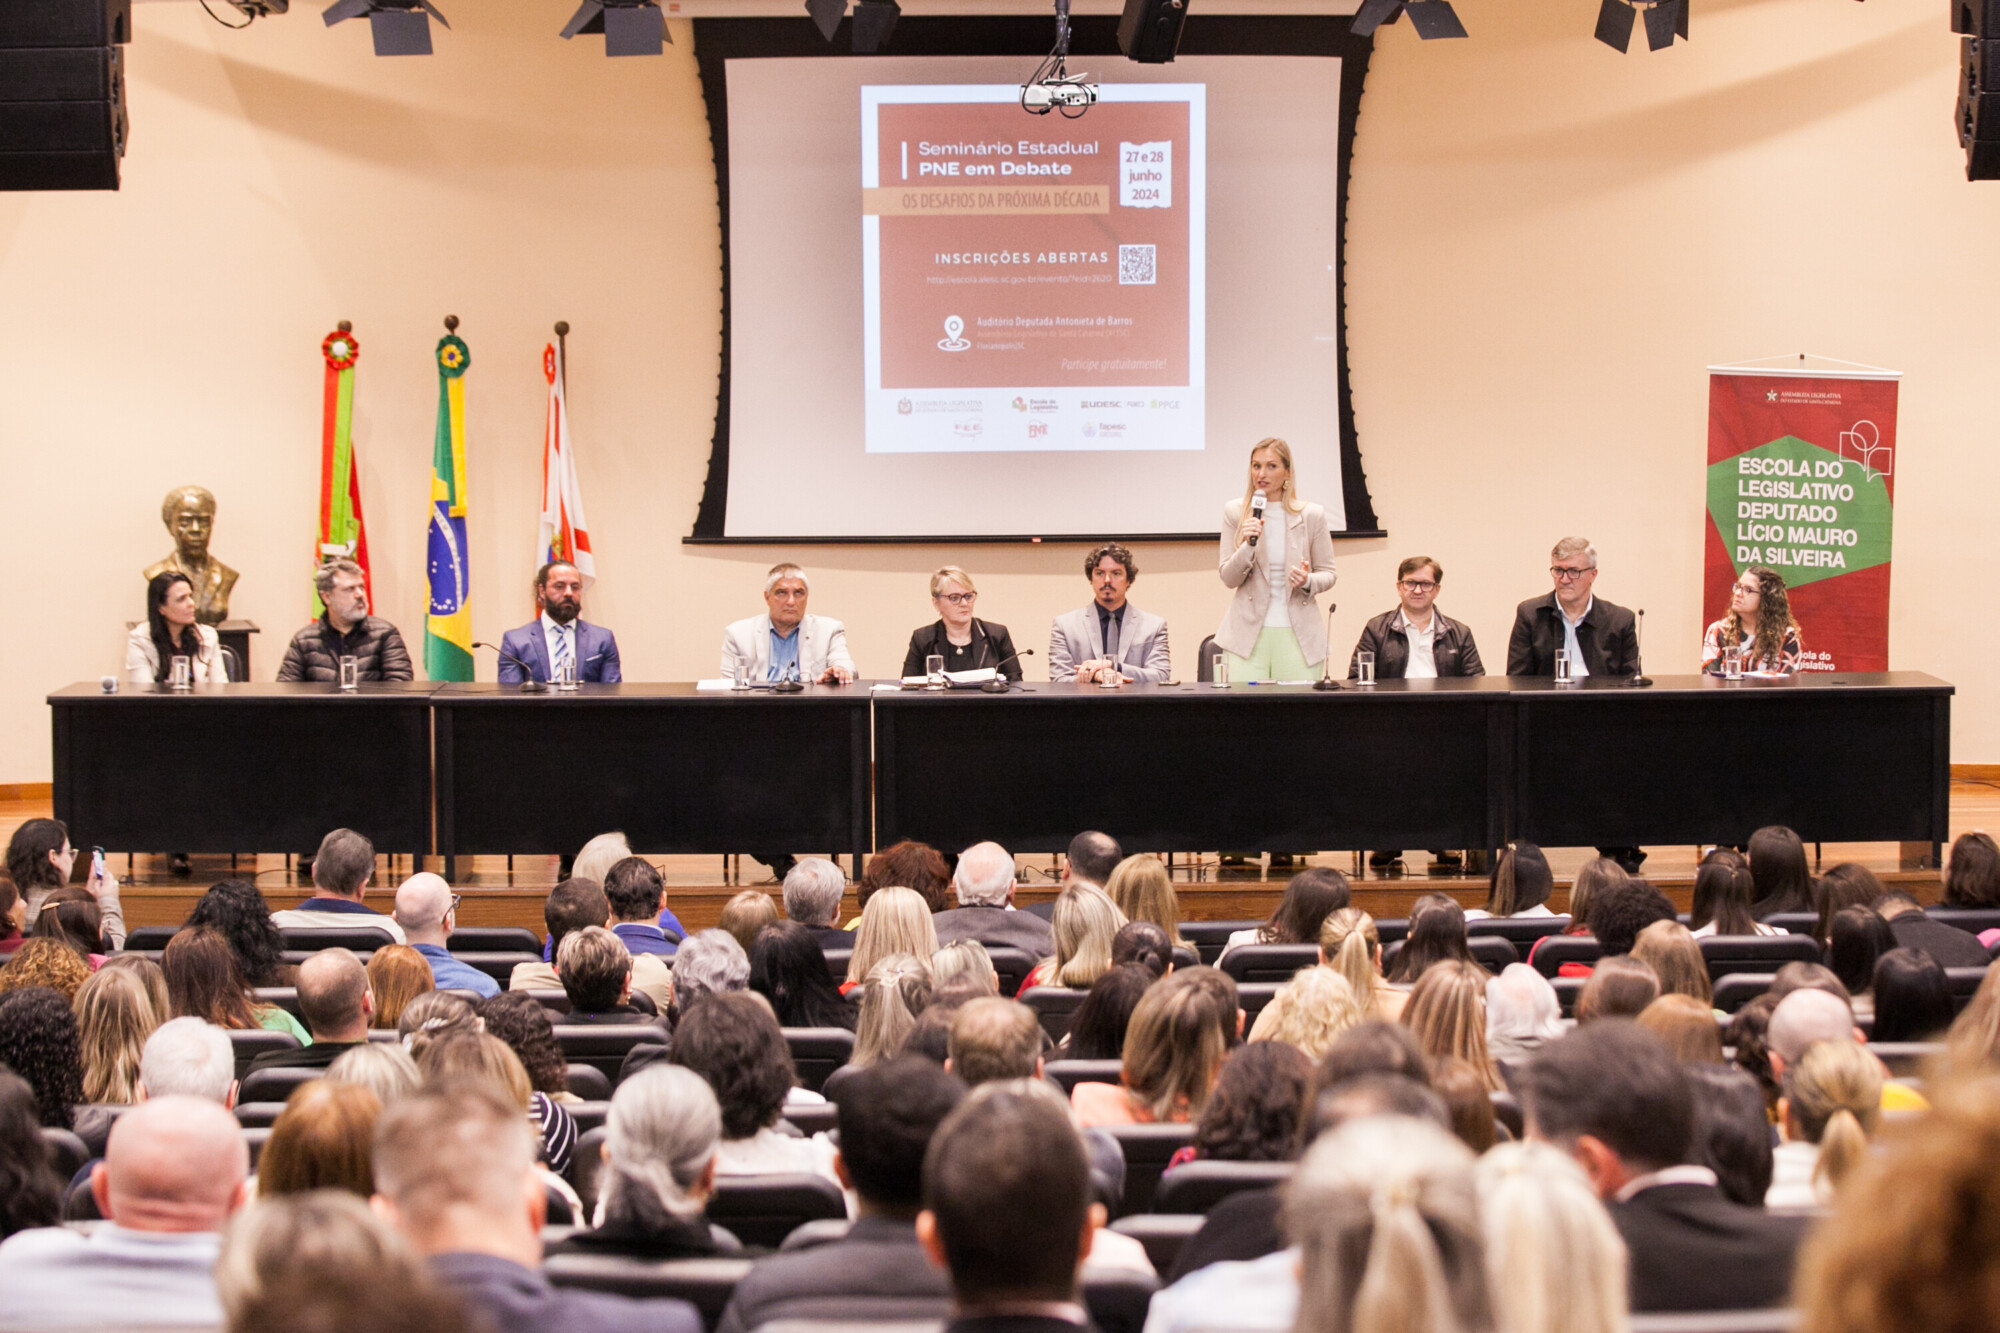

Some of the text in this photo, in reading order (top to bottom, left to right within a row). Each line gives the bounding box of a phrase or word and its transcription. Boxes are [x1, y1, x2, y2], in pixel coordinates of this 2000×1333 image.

[919, 140, 1099, 156] Seminário Estadual
[1125, 151, 1164, 163] 27 e 28
[919, 161, 1072, 176] PNE em Debate
[1128, 169, 1162, 185] junho
[902, 189, 1100, 209] OS DESAFIOS DA PRÓXIMA DÉCADA
[1132, 189, 1159, 200] 2024
[935, 250, 1108, 266] INSCRIÇÕES ABERTAS
[1016, 316, 1053, 328] Deputada
[1055, 316, 1094, 326] Antonieta
[1096, 316, 1105, 326] de
[1108, 315, 1133, 326] Barros
[1061, 358, 1167, 372] Participe gratuitamente!
[1739, 457, 1843, 479] ESCOLA DO
[1738, 479, 1854, 501] LEGISLATIVO
[1738, 501, 1837, 523] DEPUTADO
[1737, 520, 1858, 546] LÍCIO MAURO
[1737, 545, 1846, 568] DA SILVEIRA
[1818, 651, 1831, 660] do
